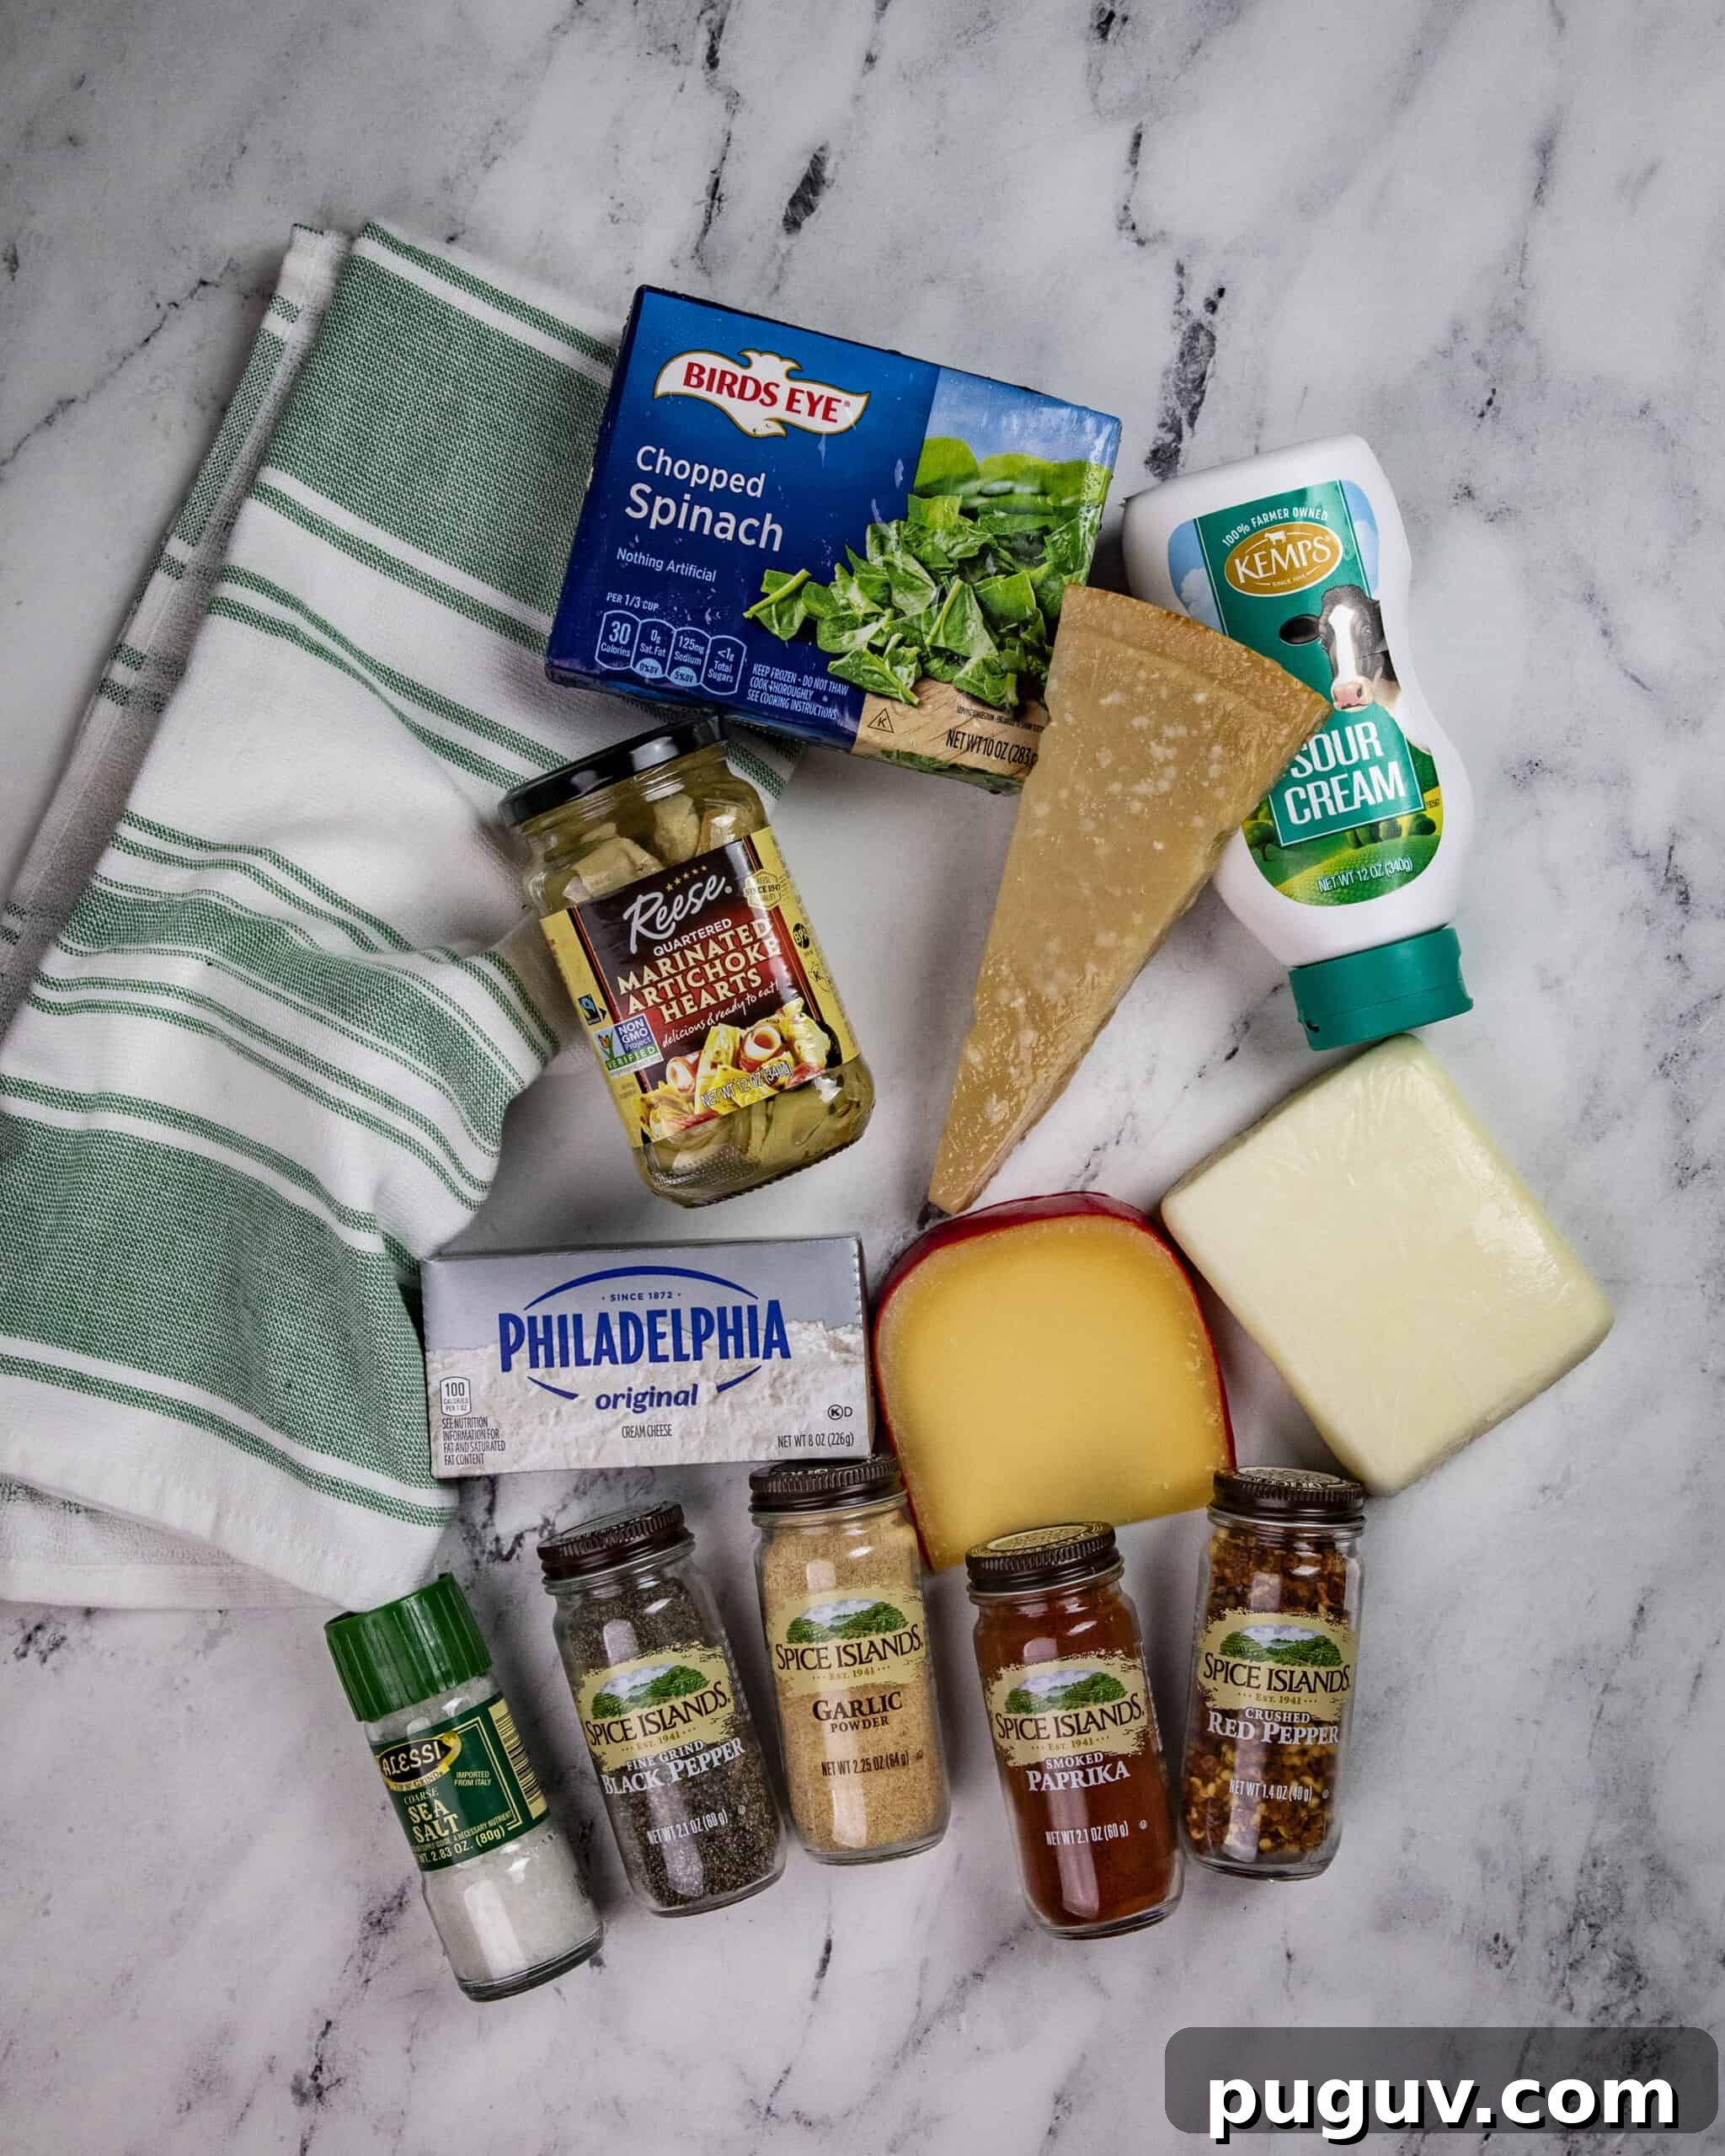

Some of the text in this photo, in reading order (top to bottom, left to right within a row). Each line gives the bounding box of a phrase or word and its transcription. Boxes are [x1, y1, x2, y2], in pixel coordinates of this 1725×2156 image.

[682, 361, 841, 424] BIRDS EYE
[636, 446, 766, 498] Chopped
[625, 483, 783, 552] Spinach
[1222, 506, 1328, 547] 100% FARMER OWNED
[617, 547, 717, 582] Nothing Artificial
[1234, 536, 1332, 584] KEMPS
[606, 592, 659, 611] PER 1/3 CUP
[609, 621, 632, 644] 30
[678, 636, 704, 654] 125mg
[601, 643, 631, 657] Calories
[674, 651, 702, 666] Sodium
[708, 668, 734, 683] Sugars
[713, 660, 733, 673] Total
[750, 676, 814, 701] COOK THOROUGHLY
[752, 664, 849, 696] KEEP FROZEN DO NOT THAW
[746, 689, 837, 720] SEE COOKING INSTRUCTIONS
[946, 729, 966, 750] NET
[968, 734, 985, 753] WT
[984, 738, 995, 757] 10
[995, 741, 1008, 760] OZ
[1284, 760, 1406, 825] CREAM
[1318, 856, 1413, 893] NET WT 12 OZ (340g)
[622, 874, 726, 955] Reese
[653, 918, 732, 957] QUARTERED
[617, 918, 772, 995] MARINATED
[628, 938, 782, 1016] ARTICHOKE
[659, 968, 762, 1024] HEARTS
[662, 1021, 706, 1048] delicious
[716, 998, 747, 1022] ready
[746, 994, 756, 1006] to
[758, 979, 779, 998] eat!
[618, 1019, 644, 1035] NON
[622, 1028, 648, 1043] GMO
[624, 1037, 652, 1052] Project
[608, 1046, 655, 1069] VERIFIED
[701, 1090, 719, 1106] NET
[720, 1083, 735, 1098] WT
[737, 1078, 750, 1092] 12
[750, 1071, 762, 1087] OZ
[610, 1291, 673, 1301] SINCE 1872
[498, 1299, 792, 1373] PHILADELPHIA
[445, 1382, 465, 1396] 100
[595, 1384, 698, 1413] original
[442, 1417, 488, 1429] SEE NUTRITION
[443, 1428, 499, 1441] INFORMATION FOR
[622, 1424, 672, 1438] CREAM CHEESE
[444, 1440, 505, 1453] FAT AND SATURATED
[777, 1431, 854, 1449] NET WT 8 OZ (226g)
[445, 1453, 484, 1465] FAT CONTENT
[775, 1624, 922, 1671] SPICE ISLANDS
[852, 1667, 874, 1678] 1941
[1204, 1652, 1350, 1694] SPICE ISLANDS
[812, 1691, 903, 1721] GARLIC
[1279, 1694, 1301, 1705] 1941
[585, 1680, 729, 1746] SPICE ISLANDS
[830, 1716, 890, 1733] POWDER
[995, 1692, 1143, 1741] SPICE ISLANDS
[1245, 1707, 1311, 1724] CRUSHED
[659, 1731, 681, 1745] 1941
[1207, 1710, 1339, 1746] RED PEPPER
[626, 1739, 705, 1771] FINE GRIND
[1071, 1737, 1093, 1748] 1941
[382, 1741, 442, 1778] ALESSI
[601, 1737, 745, 1795] BLACK PEPPER
[821, 1761, 837, 1777] NET
[838, 1759, 852, 1775] WT
[853, 1757, 873, 1774] 2.25
[873, 1755, 884, 1771] OZ
[1045, 1751, 1104, 1770] SMOKED
[456, 1770, 489, 1779] IMPORTED
[474, 1778, 492, 1786] ITALY
[1025, 1760, 1130, 1791] PAPRIKA
[404, 1786, 438, 1805] COARSE
[1229, 1779, 1245, 1796] NET
[1246, 1780, 1260, 1797] WT
[1262, 1782, 1274, 1799] 1.4
[1276, 1784, 1288, 1801] OZ
[408, 1799, 450, 1824] SEA
[413, 1813, 460, 1843] SALT
[647, 1829, 662, 1845] NET
[661, 1825, 675, 1843] WT
[677, 1821, 689, 1838] 2.1
[690, 1817, 702, 1834] OZ
[1045, 1830, 1061, 1846] NET
[1061, 1828, 1076, 1845] WT
[1077, 1827, 1089, 1844] 2.1
[1091, 1825, 1103, 1842] OZ
[431, 1847, 452, 1861] 2.83
[453, 1840, 473, 1854] OZ.
[475, 1825, 505, 1848] (80g)
